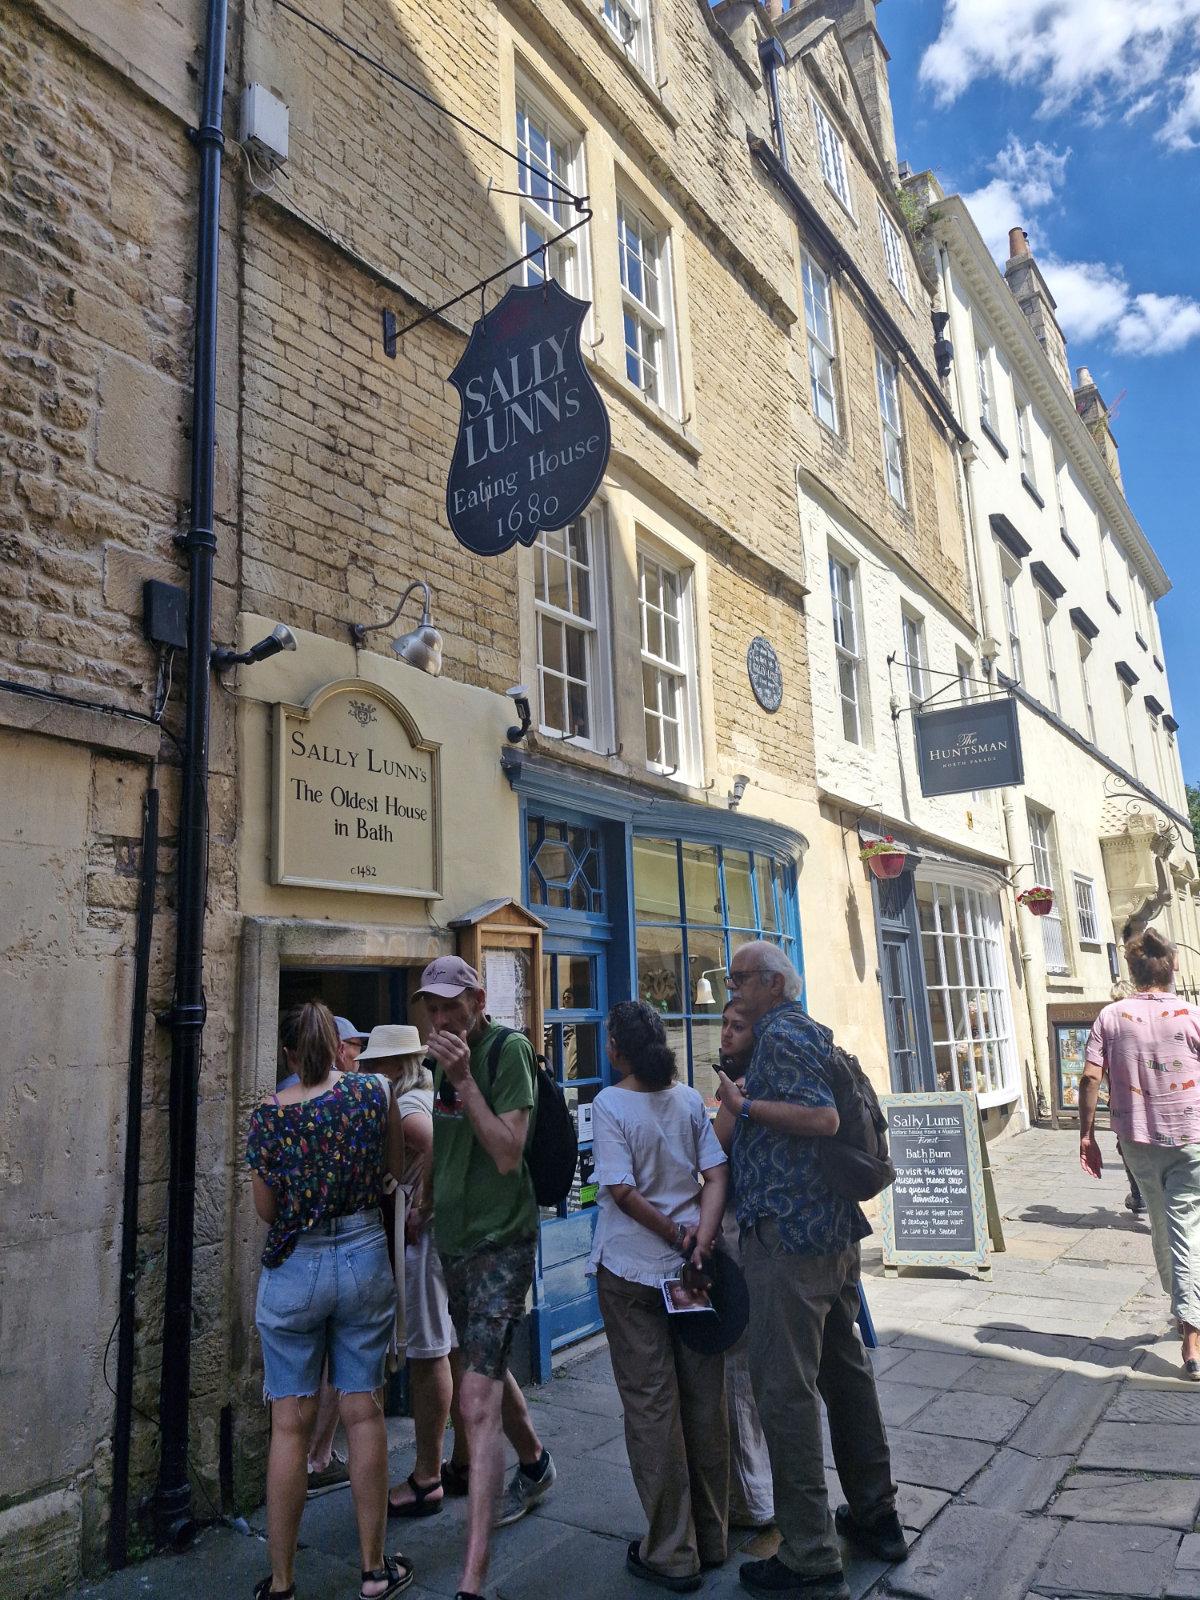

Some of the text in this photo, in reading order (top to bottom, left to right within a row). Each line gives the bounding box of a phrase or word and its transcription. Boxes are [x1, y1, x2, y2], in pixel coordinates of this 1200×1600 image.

[465, 326, 573, 421] SALLY
[454, 434, 600, 516] Eating House
[497, 492, 560, 537] 1680
[956, 732, 978, 746] The
[929, 740, 1008, 761] HUNTSMAN
[290, 778, 428, 822] The Oldest House
[334, 818, 394, 843] in Bath
[350, 864, 377, 878] c1482
[893, 1114, 960, 1130] Sally Lunn's
[906, 1148, 952, 1159] Bath Bunn
[894, 1168, 904, 1176] To
[906, 1167, 922, 1176] visit
[924, 1167, 936, 1176] the
[895, 1186, 907, 1194] the
[908, 1186, 931, 1195] queue
[950, 1186, 968, 1194] head
